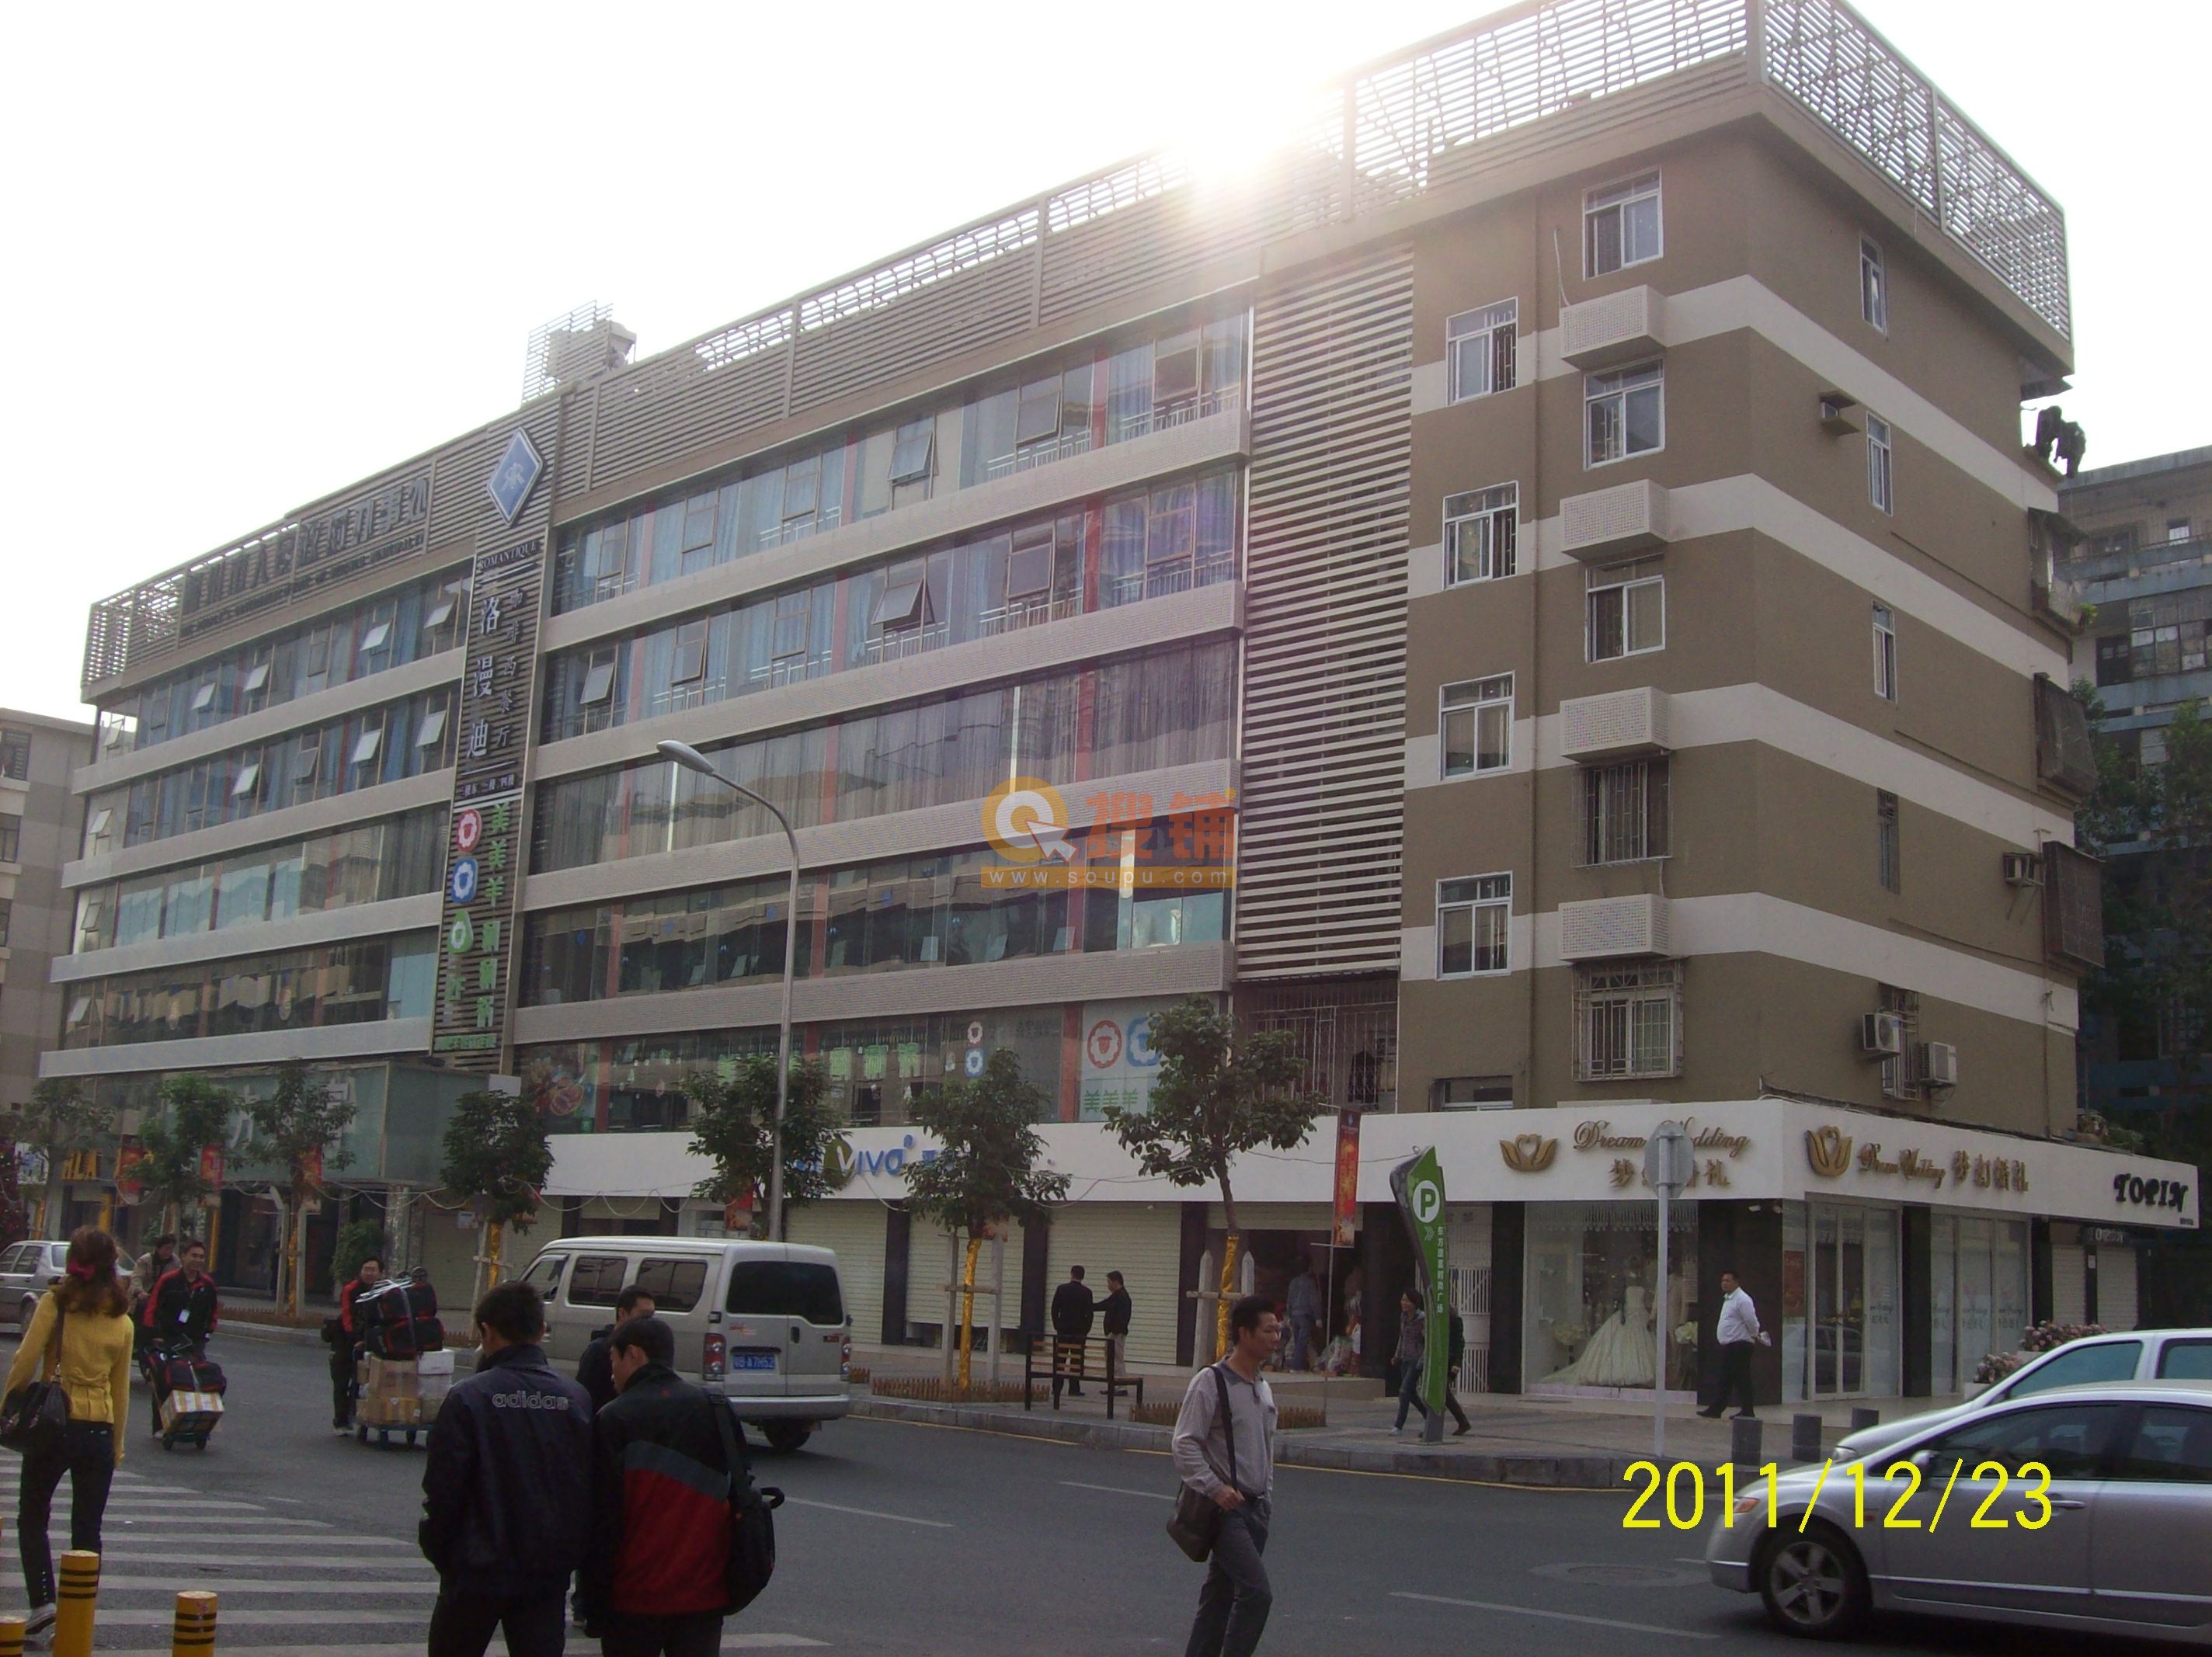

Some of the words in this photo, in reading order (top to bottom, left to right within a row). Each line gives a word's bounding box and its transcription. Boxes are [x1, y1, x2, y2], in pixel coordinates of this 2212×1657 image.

[468, 596, 500, 758] 洛漫迪
[1573, 1120, 1646, 1150] Dream
[1660, 1117, 1751, 1158] dding
[1421, 1188, 1436, 1218] P
[492, 1390, 569, 1410] adidas
